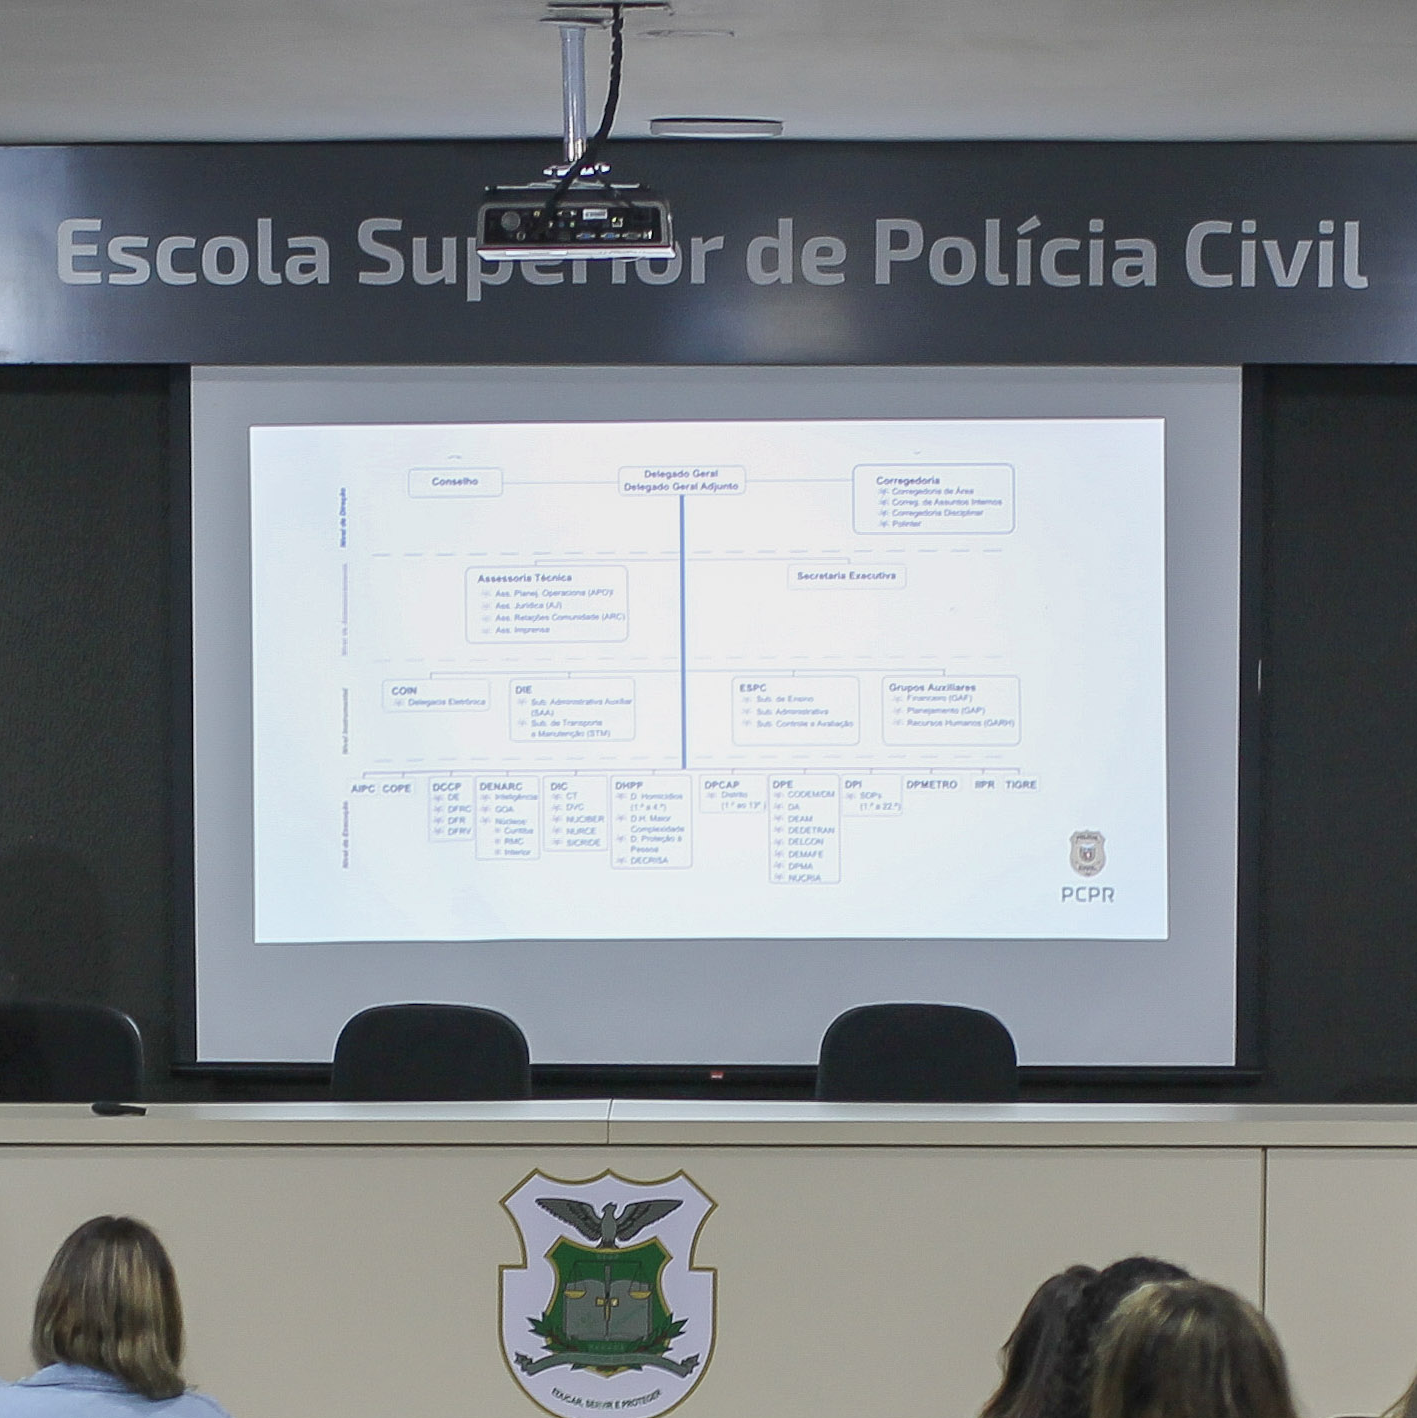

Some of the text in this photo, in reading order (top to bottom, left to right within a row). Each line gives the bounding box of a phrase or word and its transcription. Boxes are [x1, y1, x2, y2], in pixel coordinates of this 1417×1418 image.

[56, 217, 331, 286] Escola
[745, 217, 847, 286] de
[874, 214, 1158, 288] Polícia
[1184, 219, 1369, 290] Civil
[645, 469, 719, 480] Delegado Geral
[876, 476, 941, 487] Corregedoria
[624, 482, 739, 493] Delegado Geral Adjunto
[382, 783, 412, 793] COPE
[704, 780, 740, 789] DPCAP
[772, 780, 794, 789] DPE
[844, 780, 863, 789] DPI
[906, 780, 958, 789] DPMETRO
[1006, 780, 1037, 789] TIGRE
[1062, 885, 1116, 903] PCPR
